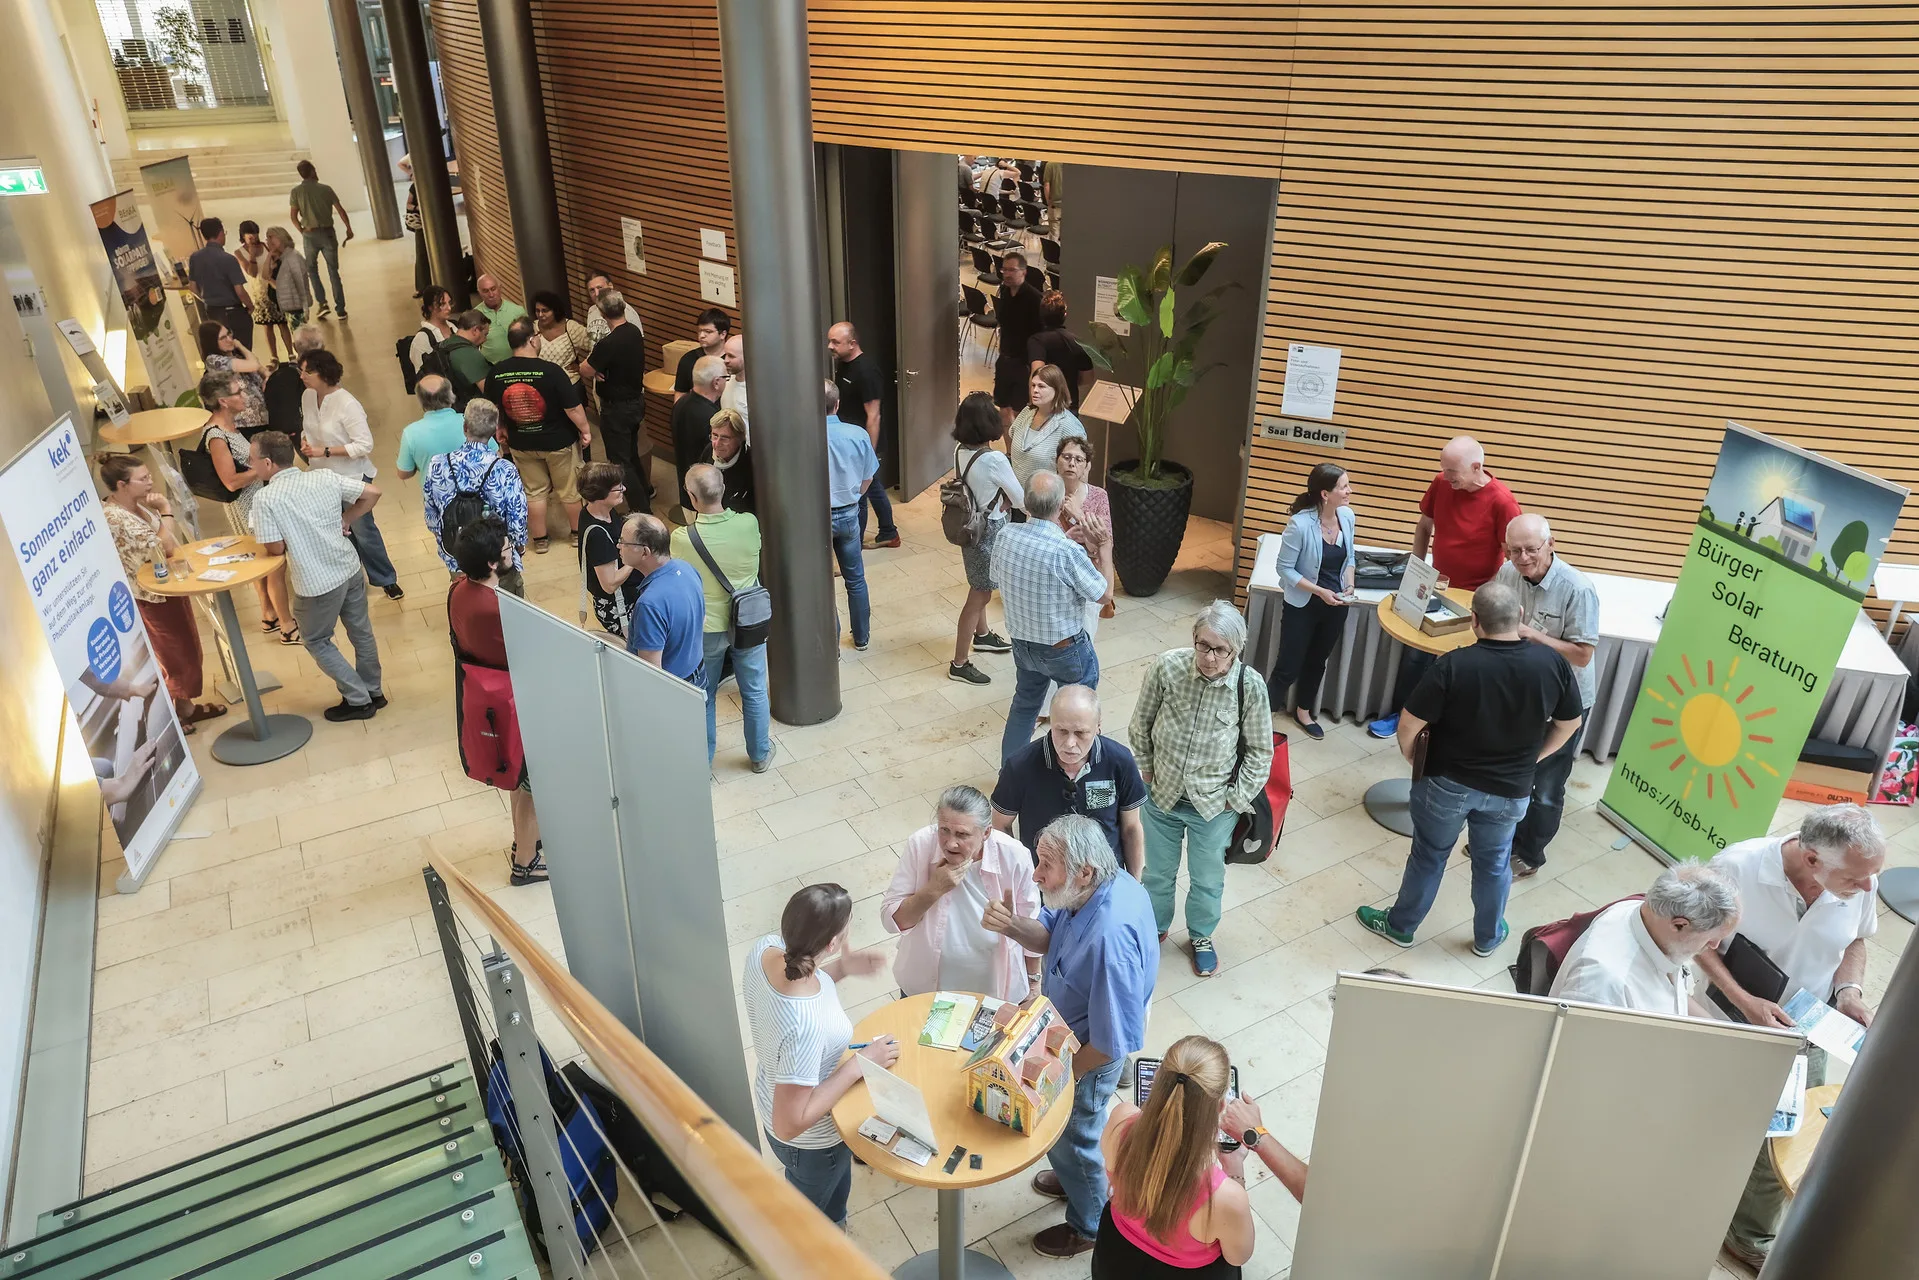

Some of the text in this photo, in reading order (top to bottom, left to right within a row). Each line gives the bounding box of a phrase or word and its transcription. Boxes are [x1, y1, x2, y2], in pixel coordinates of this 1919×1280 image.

[48, 438, 71, 468] kek
[1267, 426, 1339, 443] Saal Baden
[20, 489, 90, 564] Sonnenstrom
[32, 558, 60, 597] ganz
[60, 517, 96, 564] einfach
[1697, 537, 1763, 582] Bürger
[1712, 581, 1764, 619] Solar
[1728, 624, 1818, 693] Beratung
